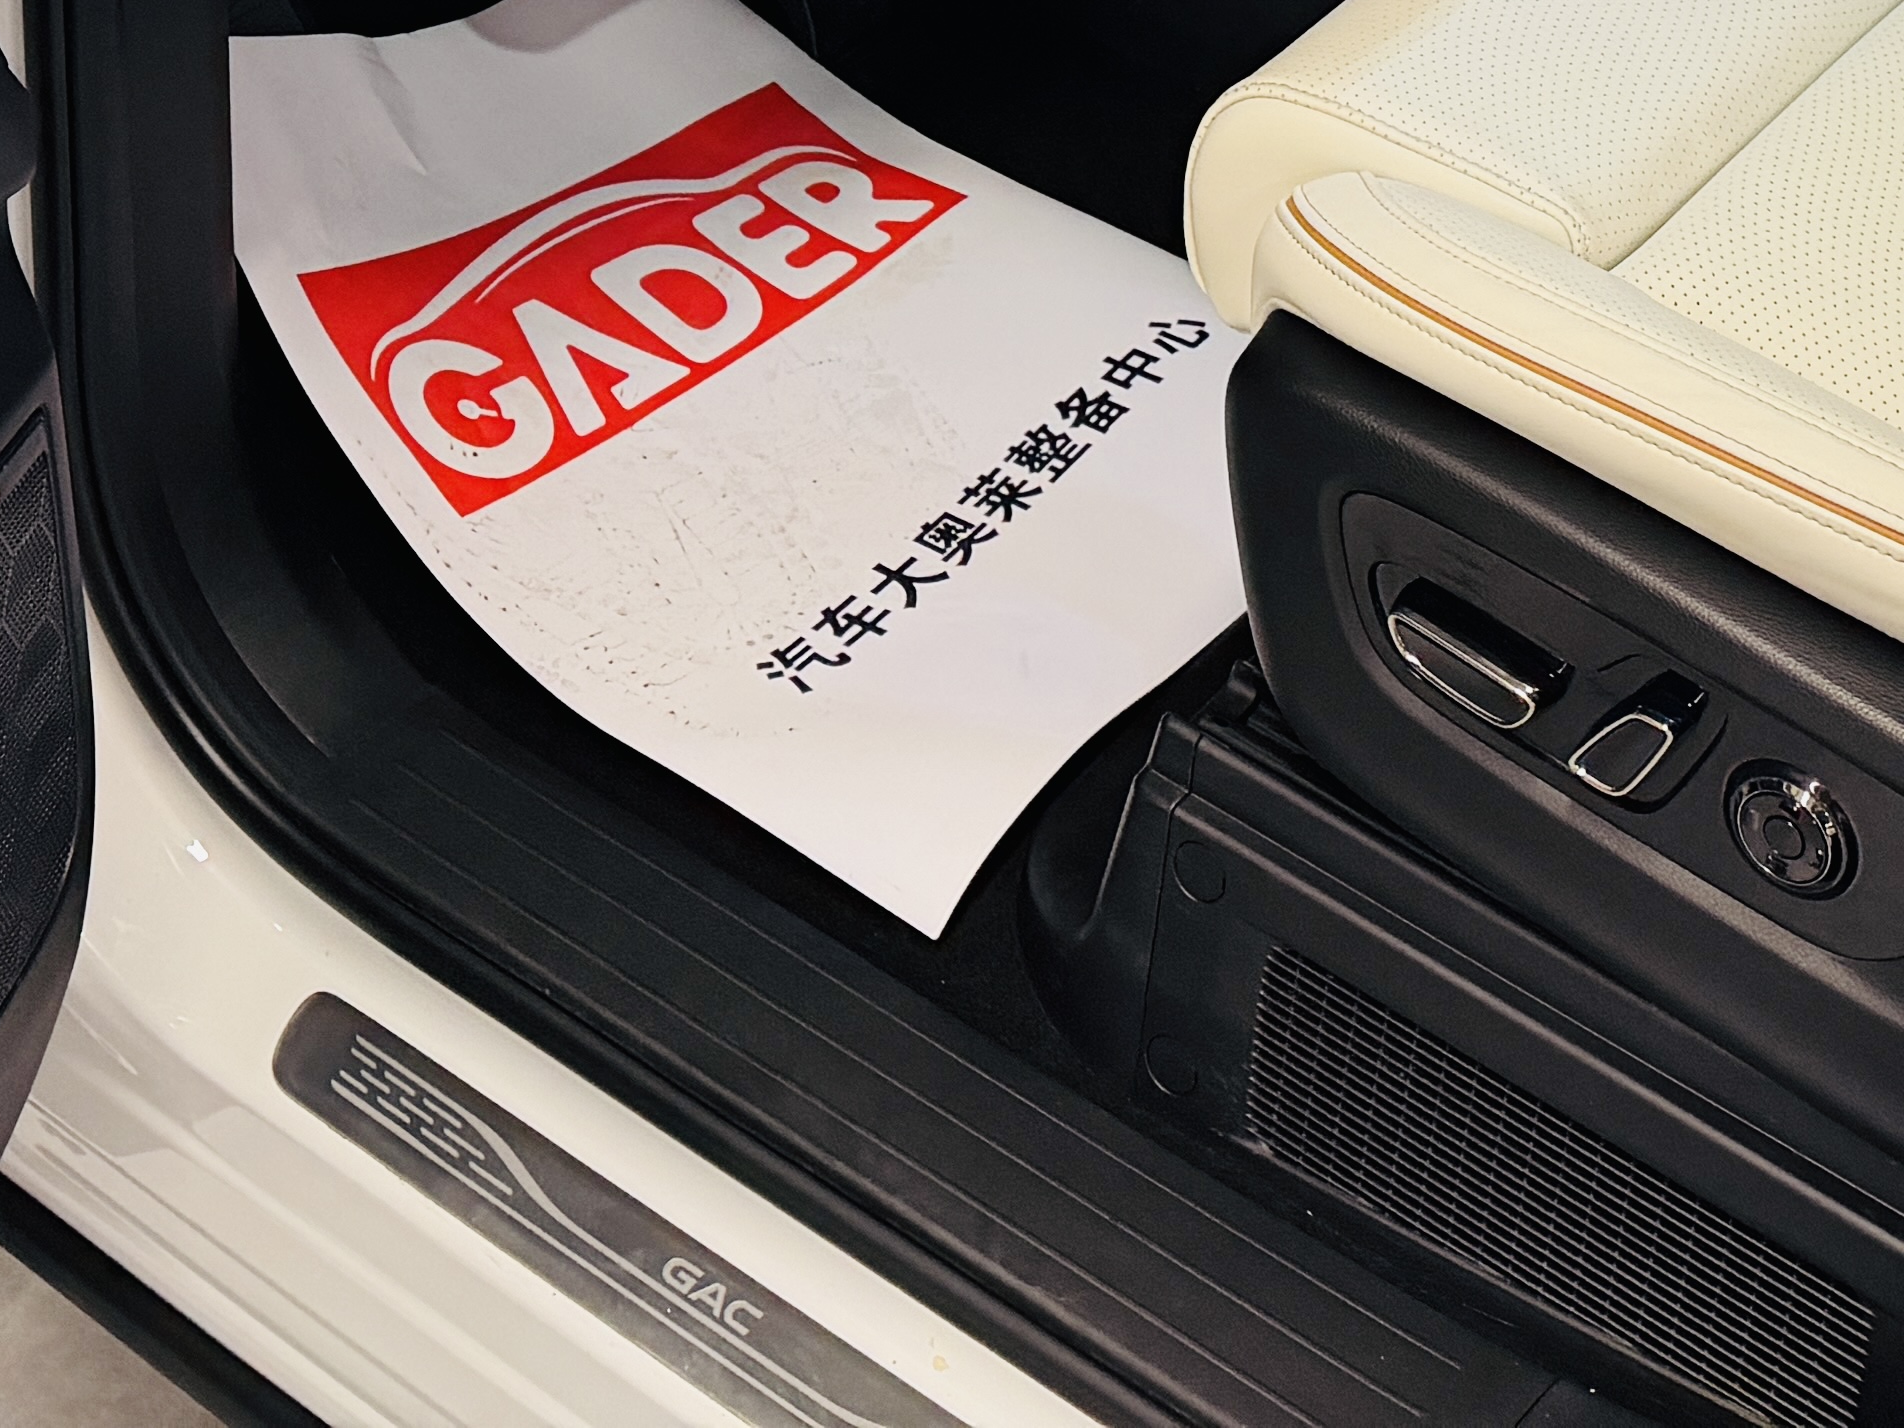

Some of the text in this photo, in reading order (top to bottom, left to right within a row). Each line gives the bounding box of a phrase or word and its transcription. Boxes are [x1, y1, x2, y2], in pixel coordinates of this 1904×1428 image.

[386, 155, 929, 481] GADER
[755, 315, 1212, 695] 汽车大奥莱整备中心
[661, 1256, 764, 1337] GAC
